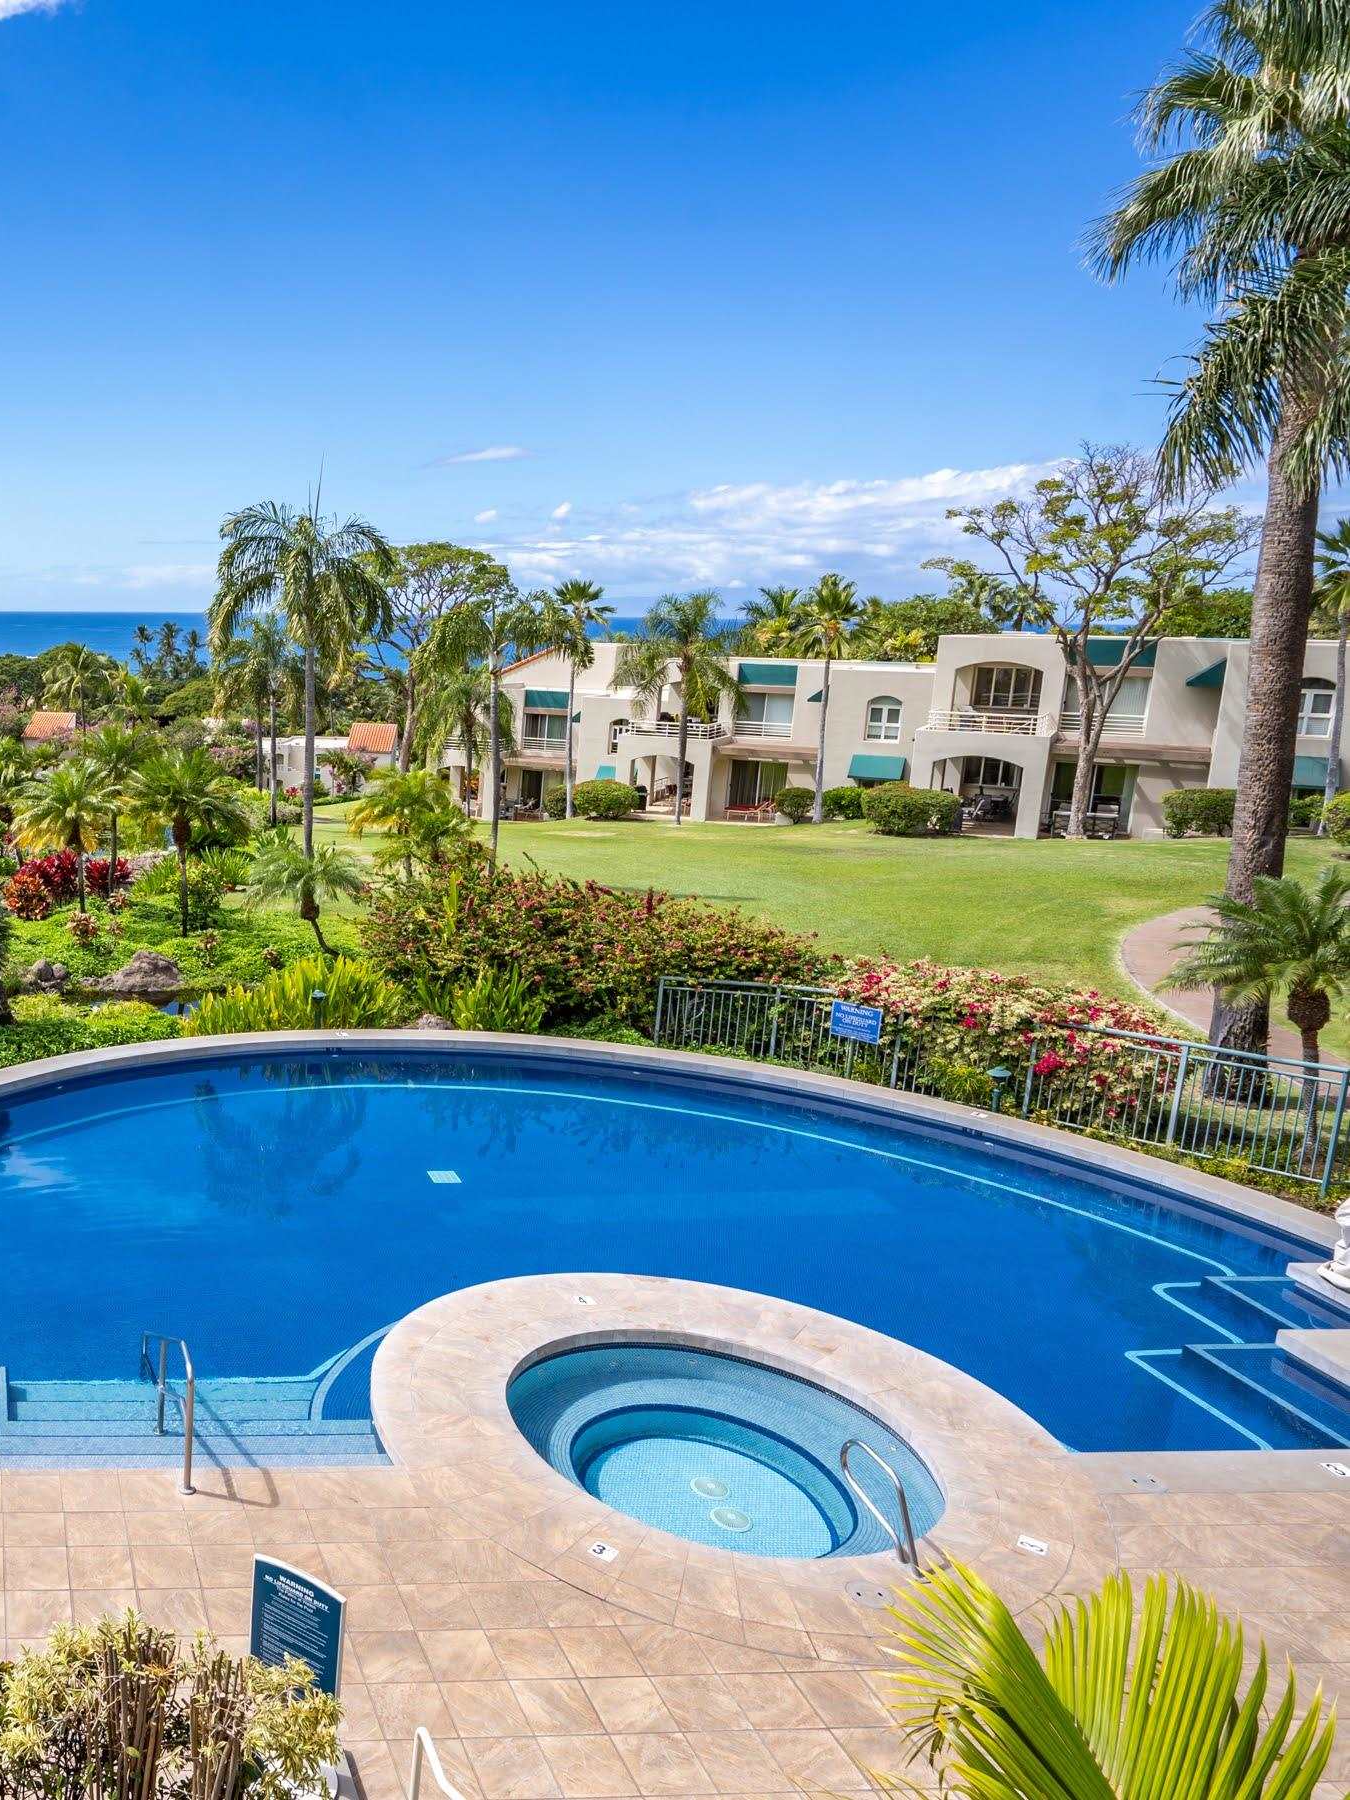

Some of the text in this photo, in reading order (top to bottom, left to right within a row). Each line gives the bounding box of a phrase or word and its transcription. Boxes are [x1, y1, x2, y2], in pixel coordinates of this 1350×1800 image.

[840, 1006, 873, 1017] WARNING
[592, 1544, 606, 1555] 3
[265, 1574, 328, 1611] NO LIFEGUARD ON DUTY
[279, 1575, 314, 1597] WARNING
